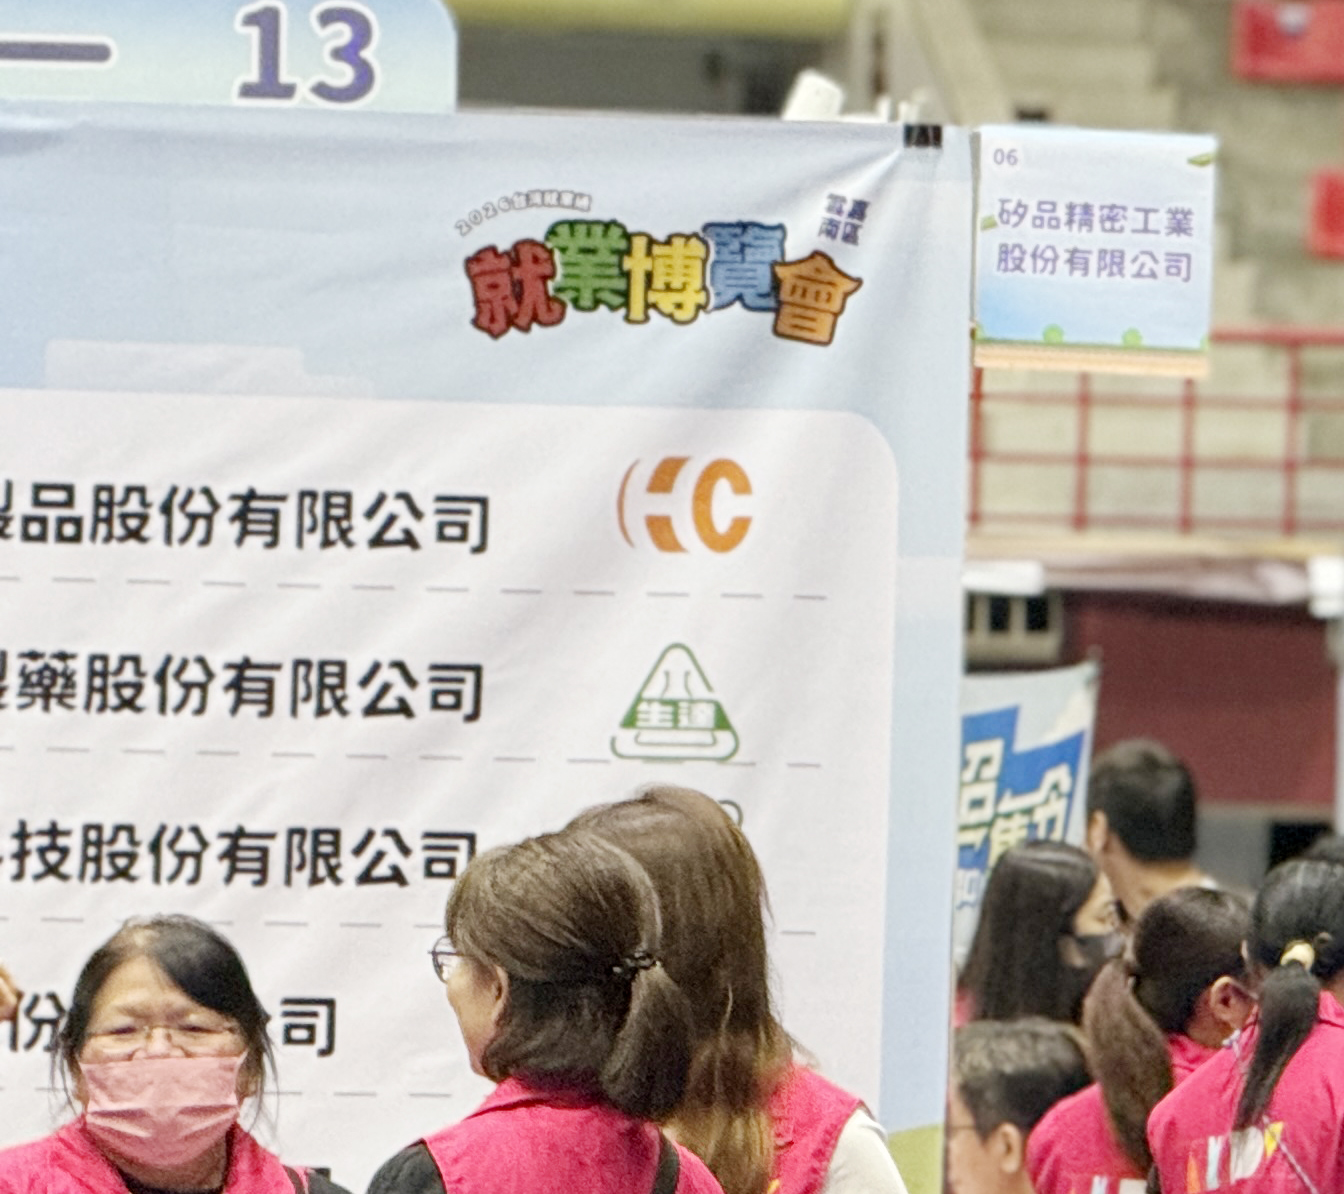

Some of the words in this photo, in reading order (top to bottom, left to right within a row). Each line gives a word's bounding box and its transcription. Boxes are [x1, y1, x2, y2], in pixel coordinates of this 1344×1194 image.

[237, 5, 377, 102] 13
[993, 148, 1019, 166] 06
[998, 198, 1195, 238] 矽品精密工業
[464, 219, 863, 347] 就業博覽會
[996, 243, 1193, 283] 股份有限公司
[0, 479, 490, 555] 品股份有限公司
[0, 650, 484, 723] 藥股份有限公司
